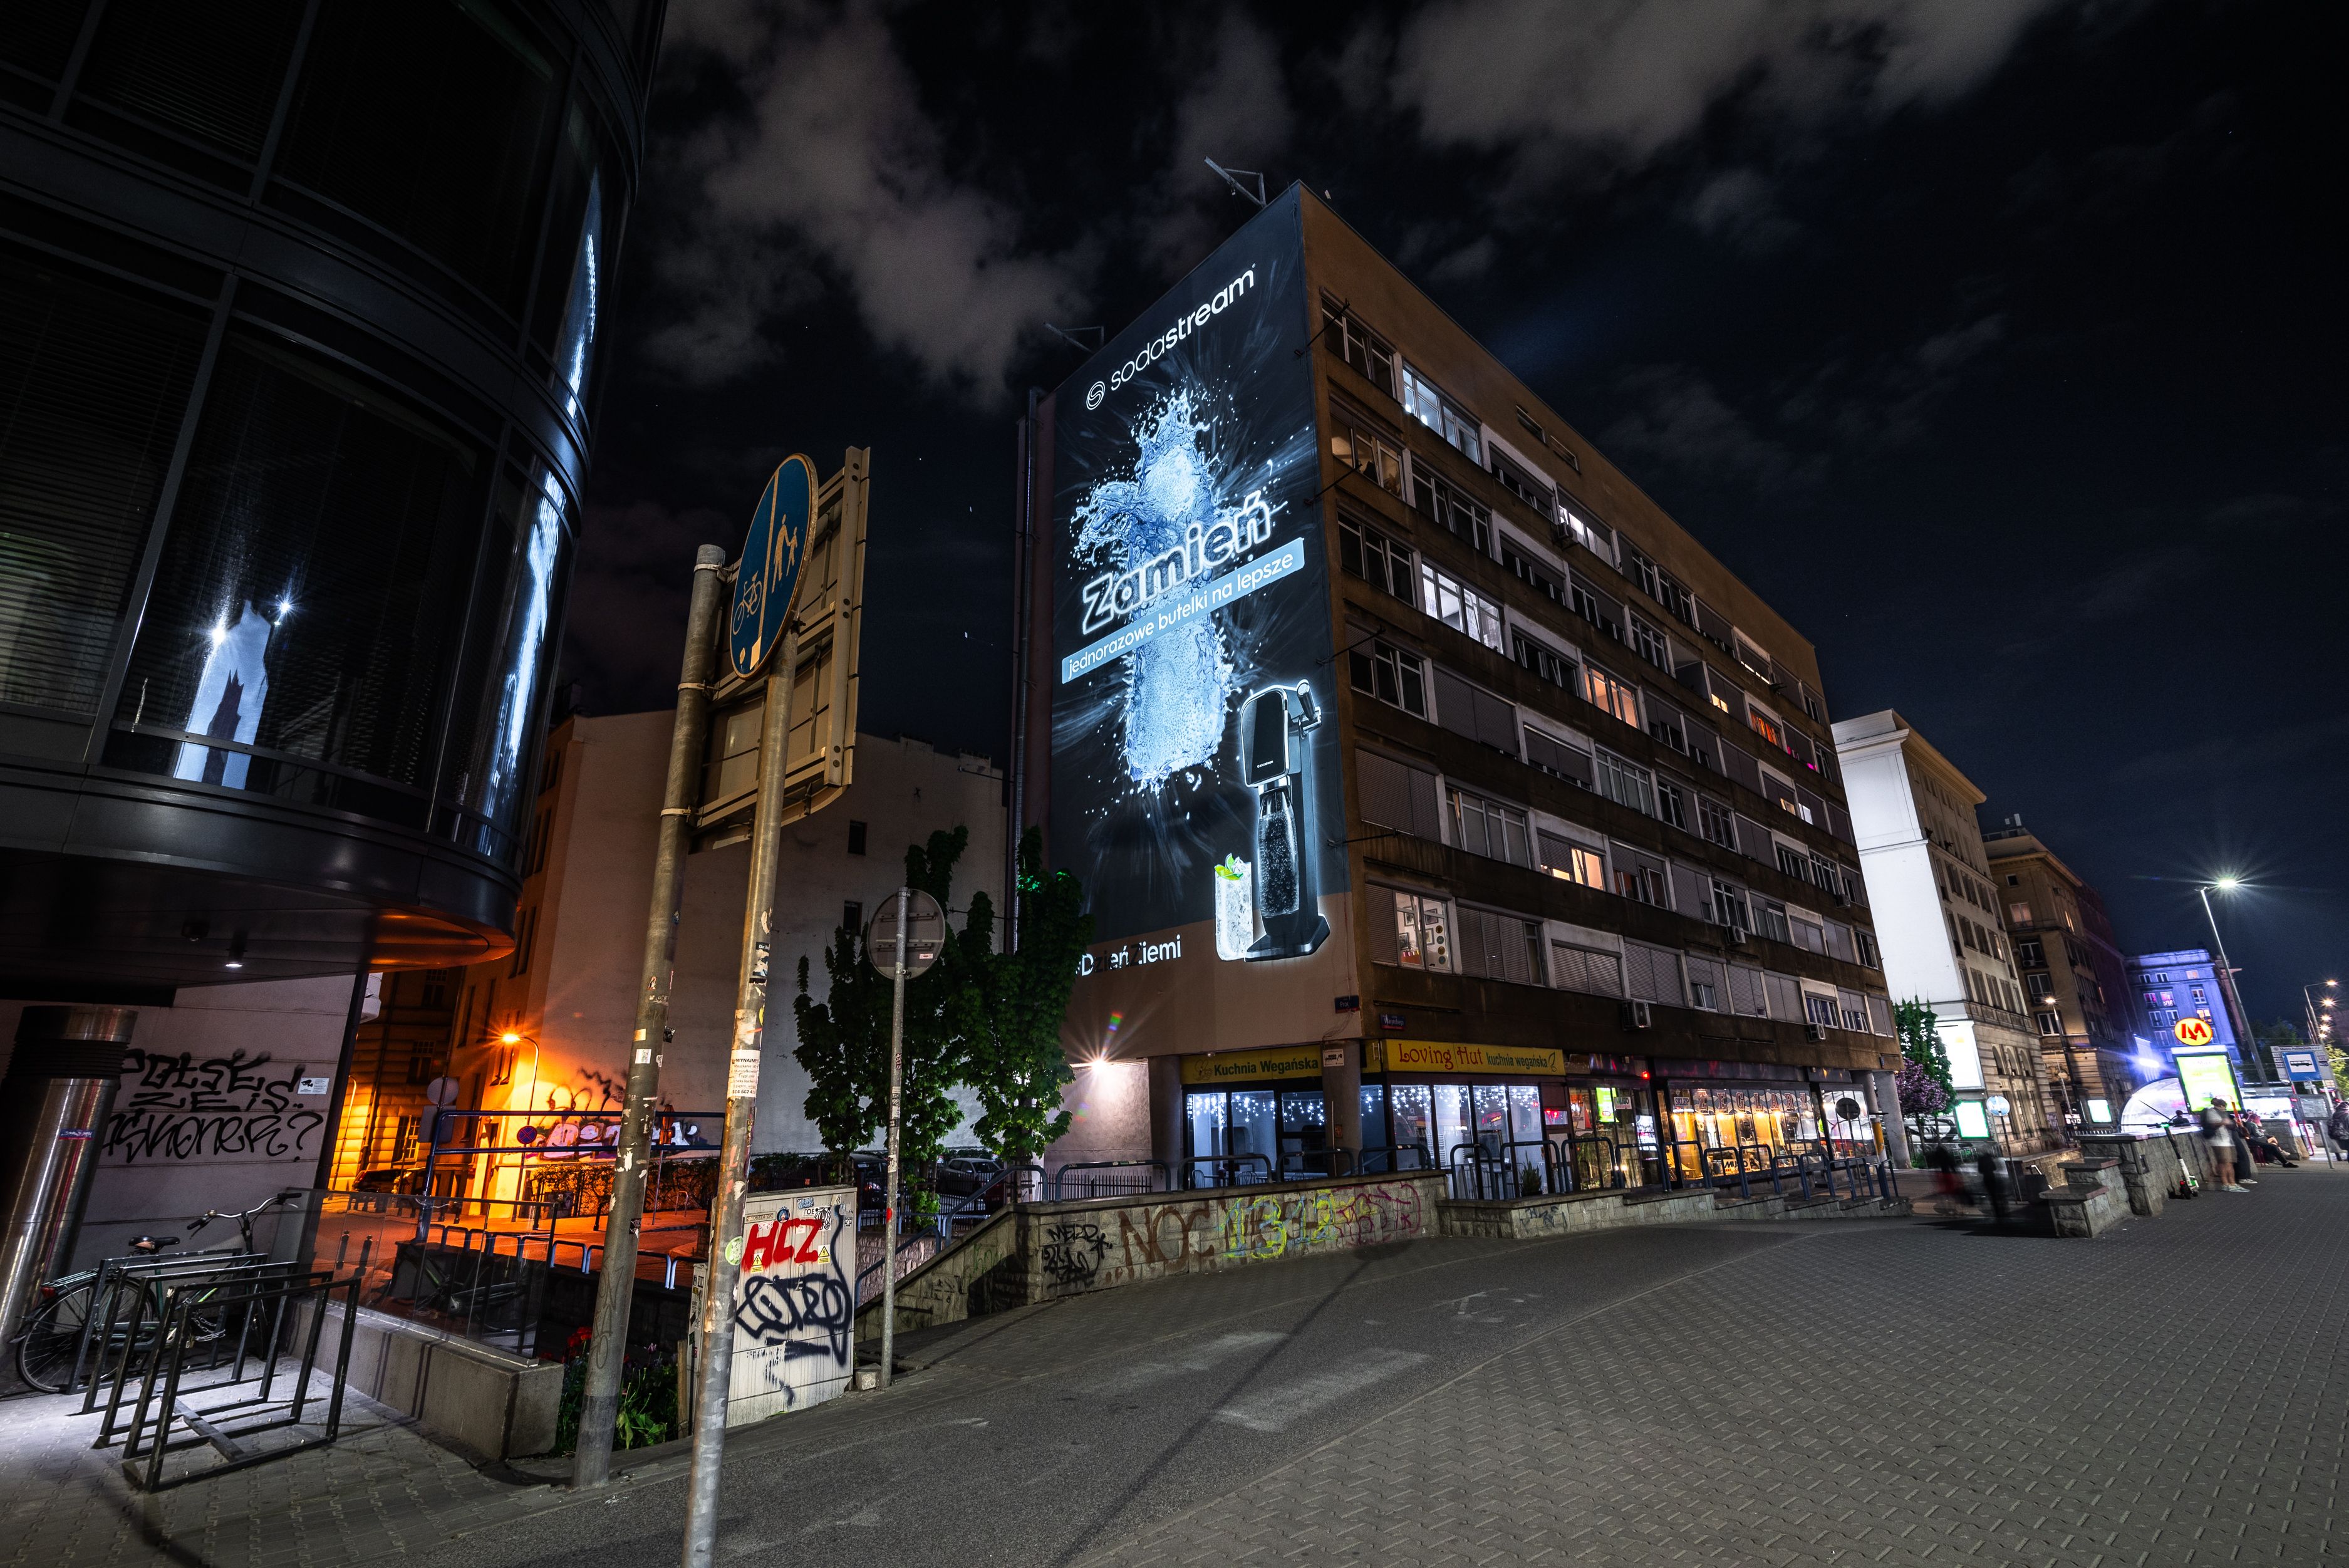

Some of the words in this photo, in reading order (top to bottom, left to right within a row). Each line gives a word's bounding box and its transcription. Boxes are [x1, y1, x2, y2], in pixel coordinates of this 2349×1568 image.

[1111, 267, 1255, 392] sodastream
[1067, 621, 1154, 679] jednorazowe
[1158, 590, 1208, 630] butelki
[1211, 581, 1233, 604] na
[1237, 553, 1294, 593] lepsze
[1082, 490, 1272, 636] Zamień
[1214, 1061, 1257, 1076] Kuchnia
[1260, 1057, 1319, 1075] Wegańska
[1398, 1043, 1454, 1070] Loving
[1456, 1046, 1483, 1065] Hut
[1486, 1052, 1514, 1066] kuchnia
[1515, 1054, 1548, 1070] wegańska
